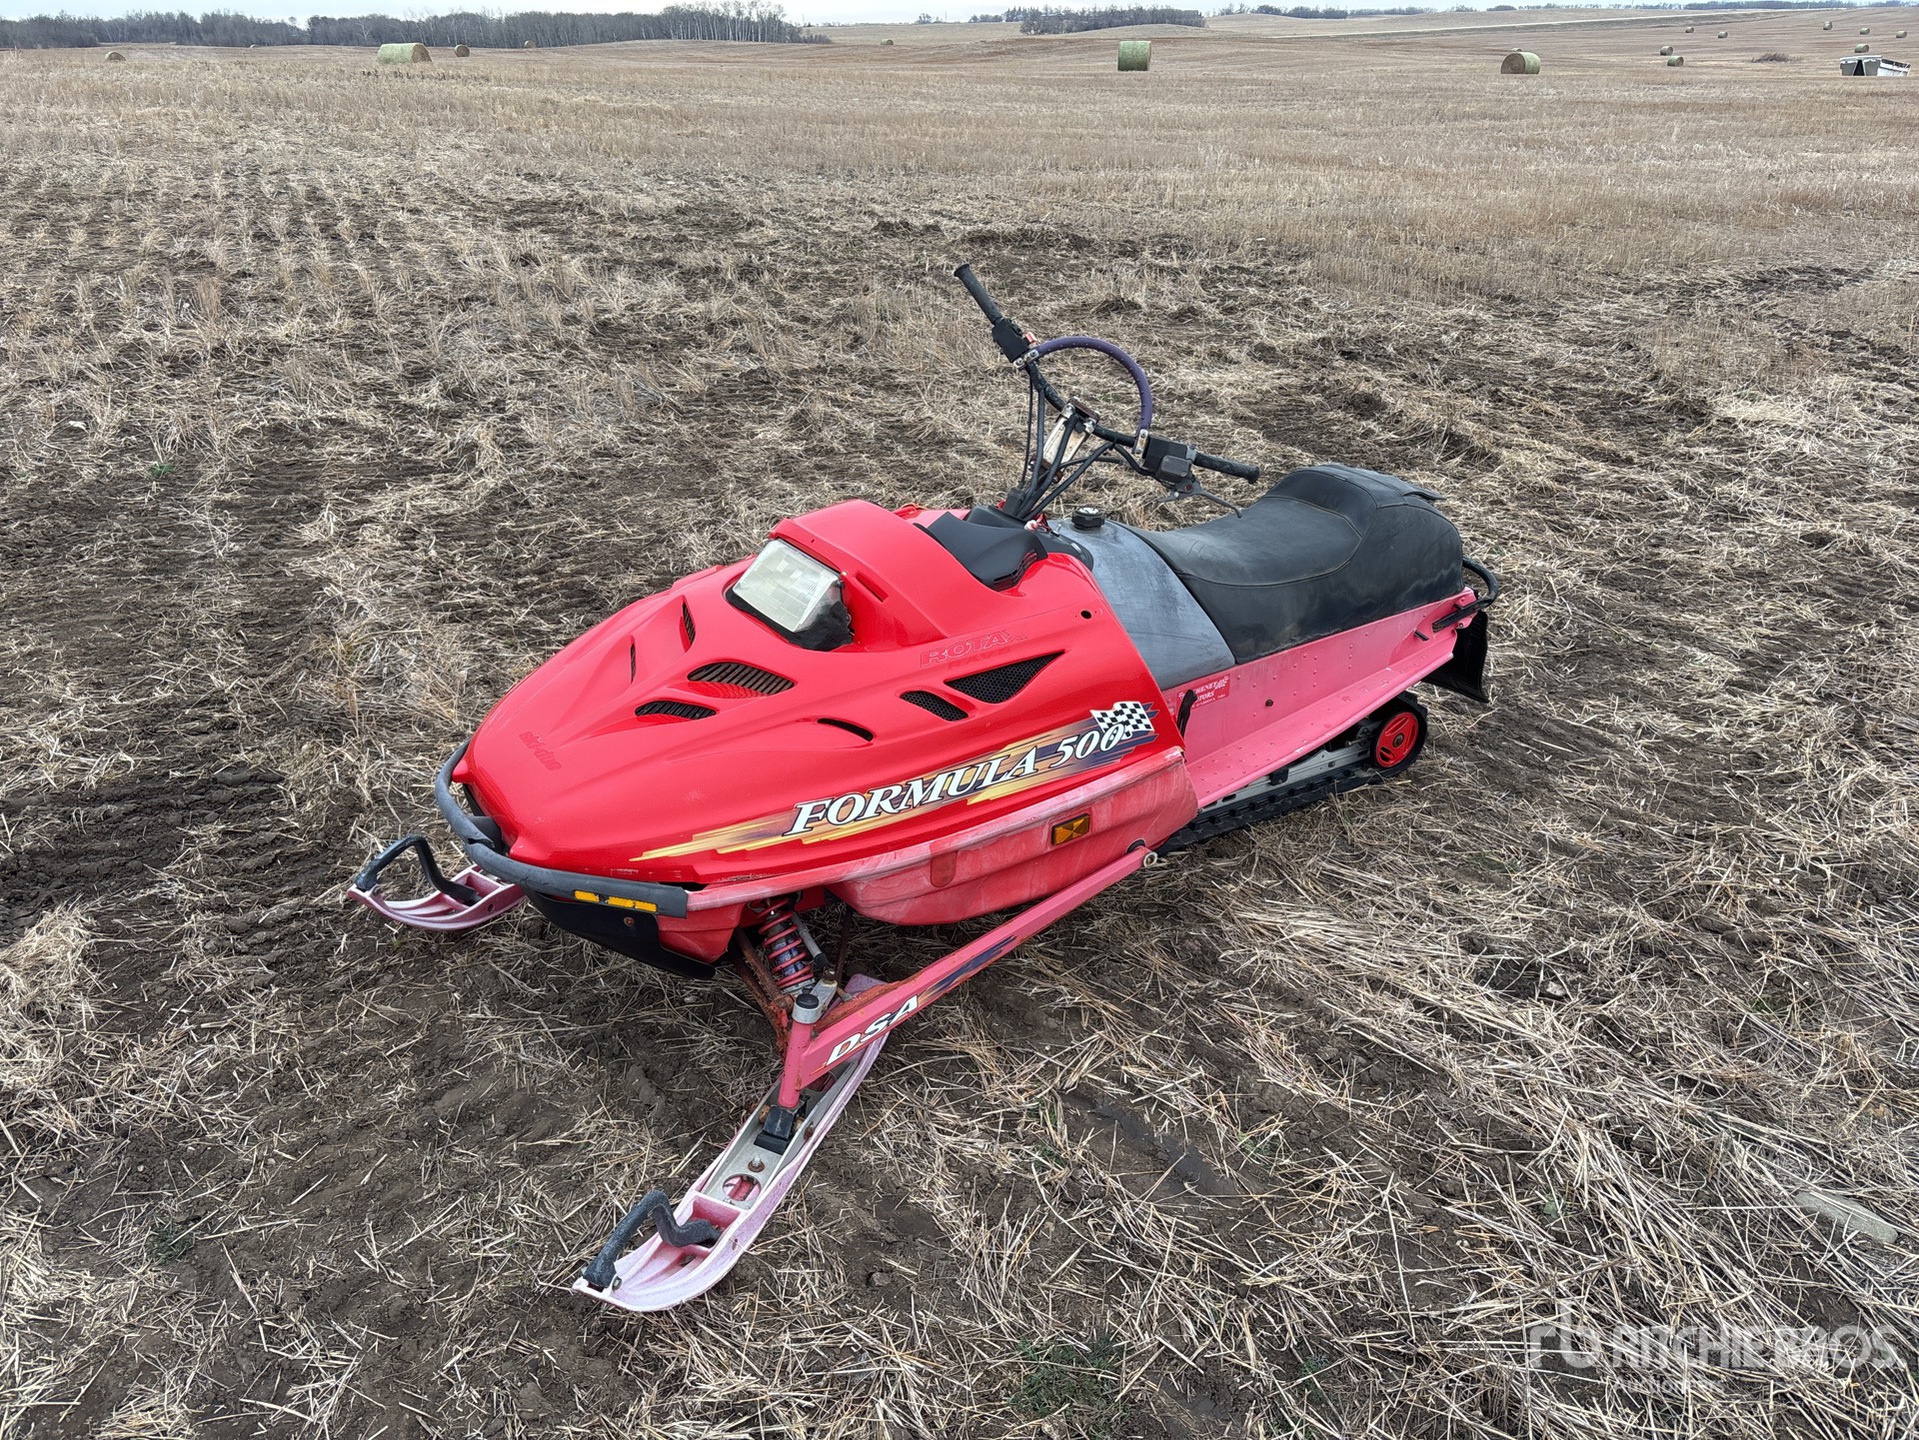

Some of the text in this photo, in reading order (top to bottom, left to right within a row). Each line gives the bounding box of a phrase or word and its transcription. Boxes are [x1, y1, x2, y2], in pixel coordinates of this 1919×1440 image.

[782, 722, 1125, 838] FORMULA 500
[825, 993, 918, 1067] DSA
